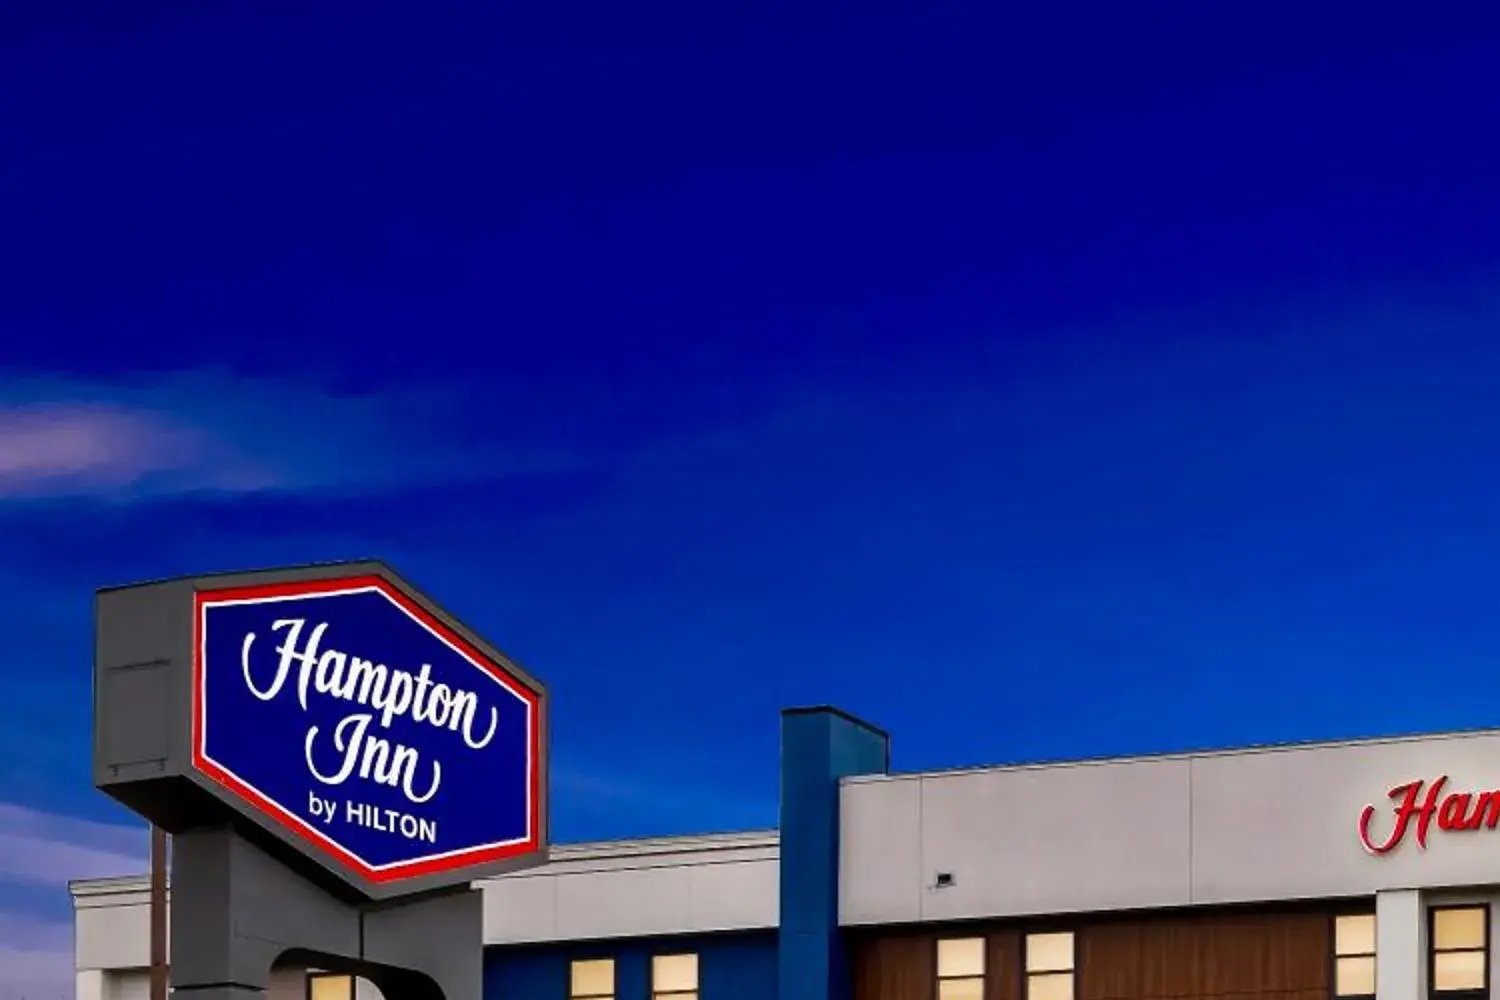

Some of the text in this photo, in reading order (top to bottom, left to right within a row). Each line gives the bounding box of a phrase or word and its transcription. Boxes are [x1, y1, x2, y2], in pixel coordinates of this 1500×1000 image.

[241, 619, 498, 749] Hampton
[305, 714, 441, 803] Inn
[309, 790, 437, 844] by HILTON
